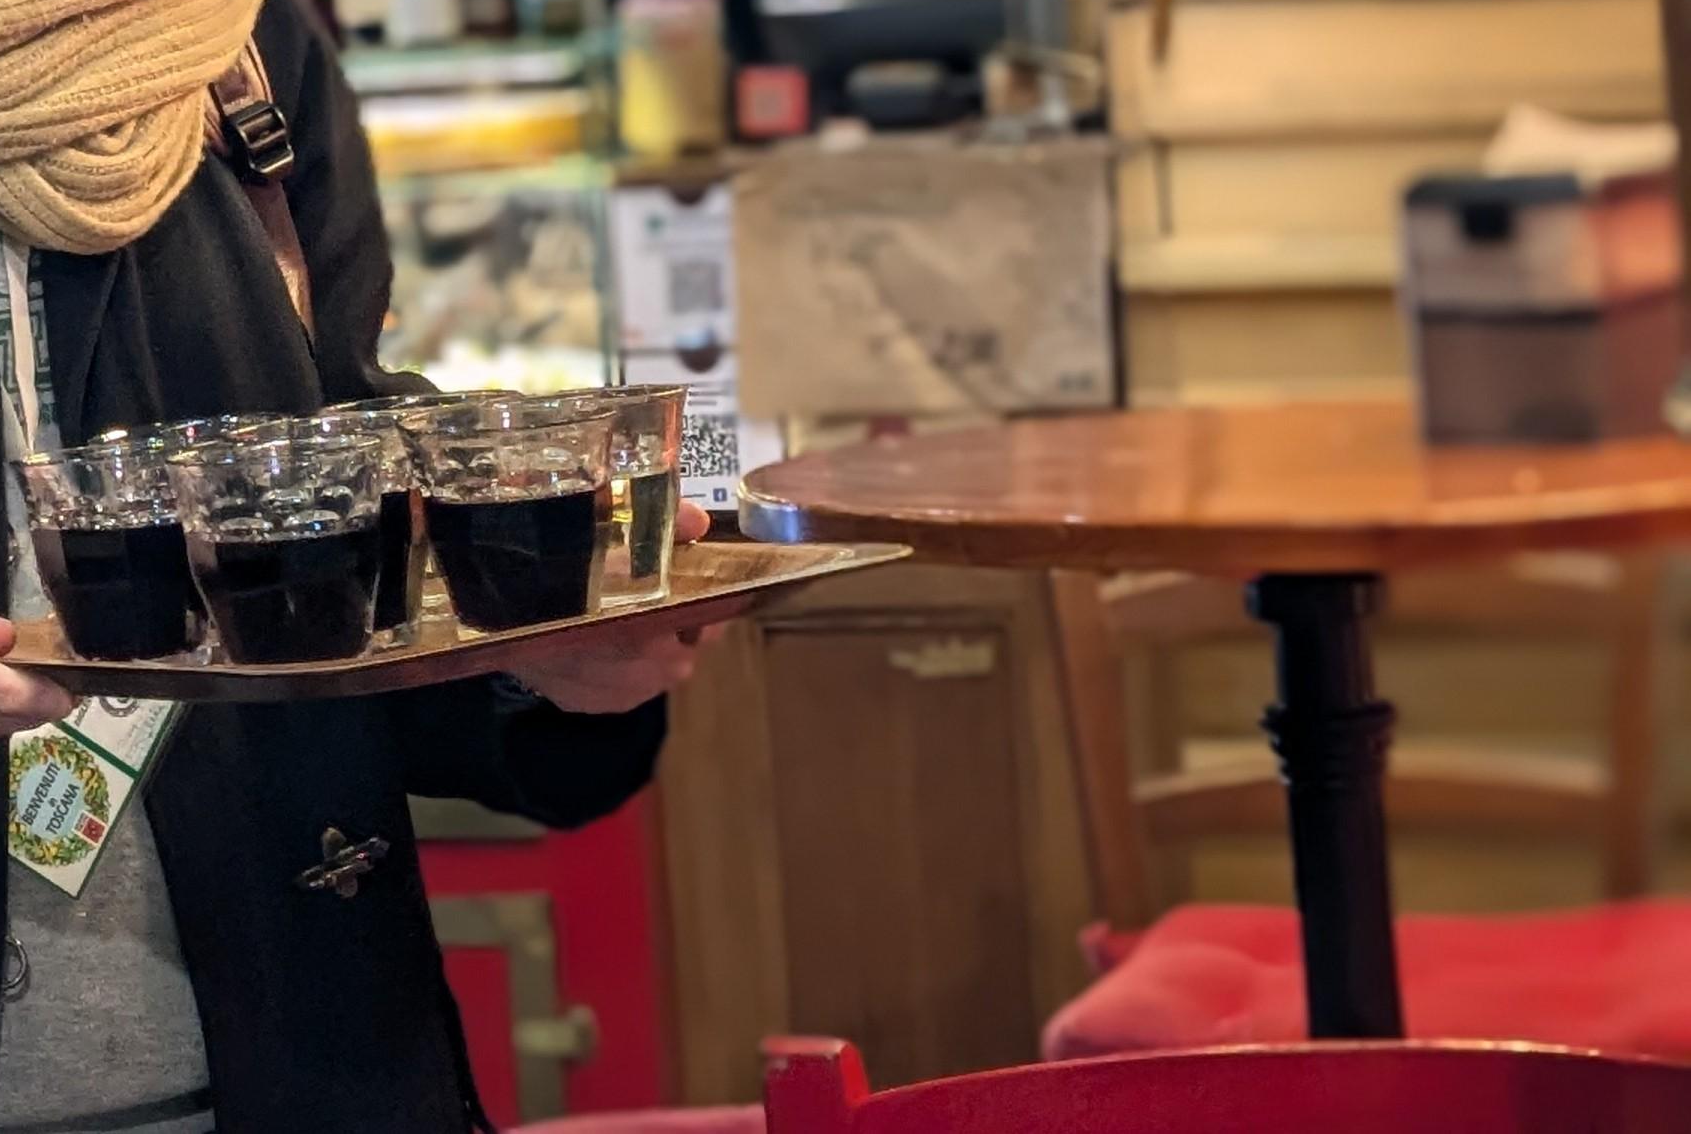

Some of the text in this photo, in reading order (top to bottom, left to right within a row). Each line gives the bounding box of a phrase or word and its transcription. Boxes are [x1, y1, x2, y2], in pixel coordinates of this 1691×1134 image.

[21, 762, 61, 826] BENVENUTI
[45, 783, 80, 835] TOSCANA
[48, 797, 58, 808] in
